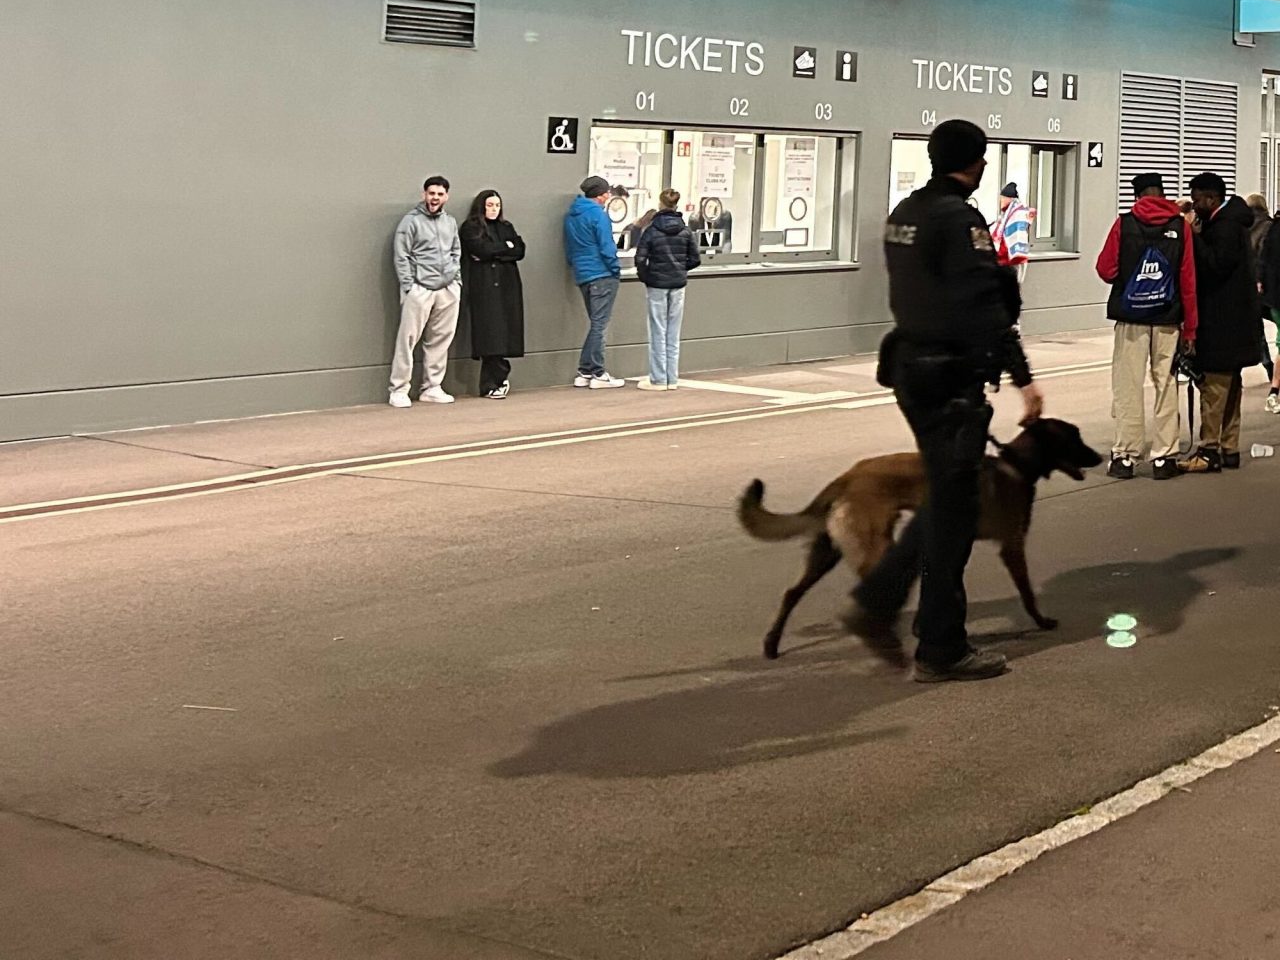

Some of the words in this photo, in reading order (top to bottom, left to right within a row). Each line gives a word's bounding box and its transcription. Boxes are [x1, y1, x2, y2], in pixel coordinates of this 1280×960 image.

[621, 29, 764, 76] TICKETS
[911, 58, 1013, 96] TICKETS
[635, 91, 655, 111] 01
[729, 97, 749, 116] 02
[815, 103, 832, 120] 03
[921, 109, 937, 126] 04
[988, 114, 1001, 130] 05
[1047, 118, 1061, 133] 06
